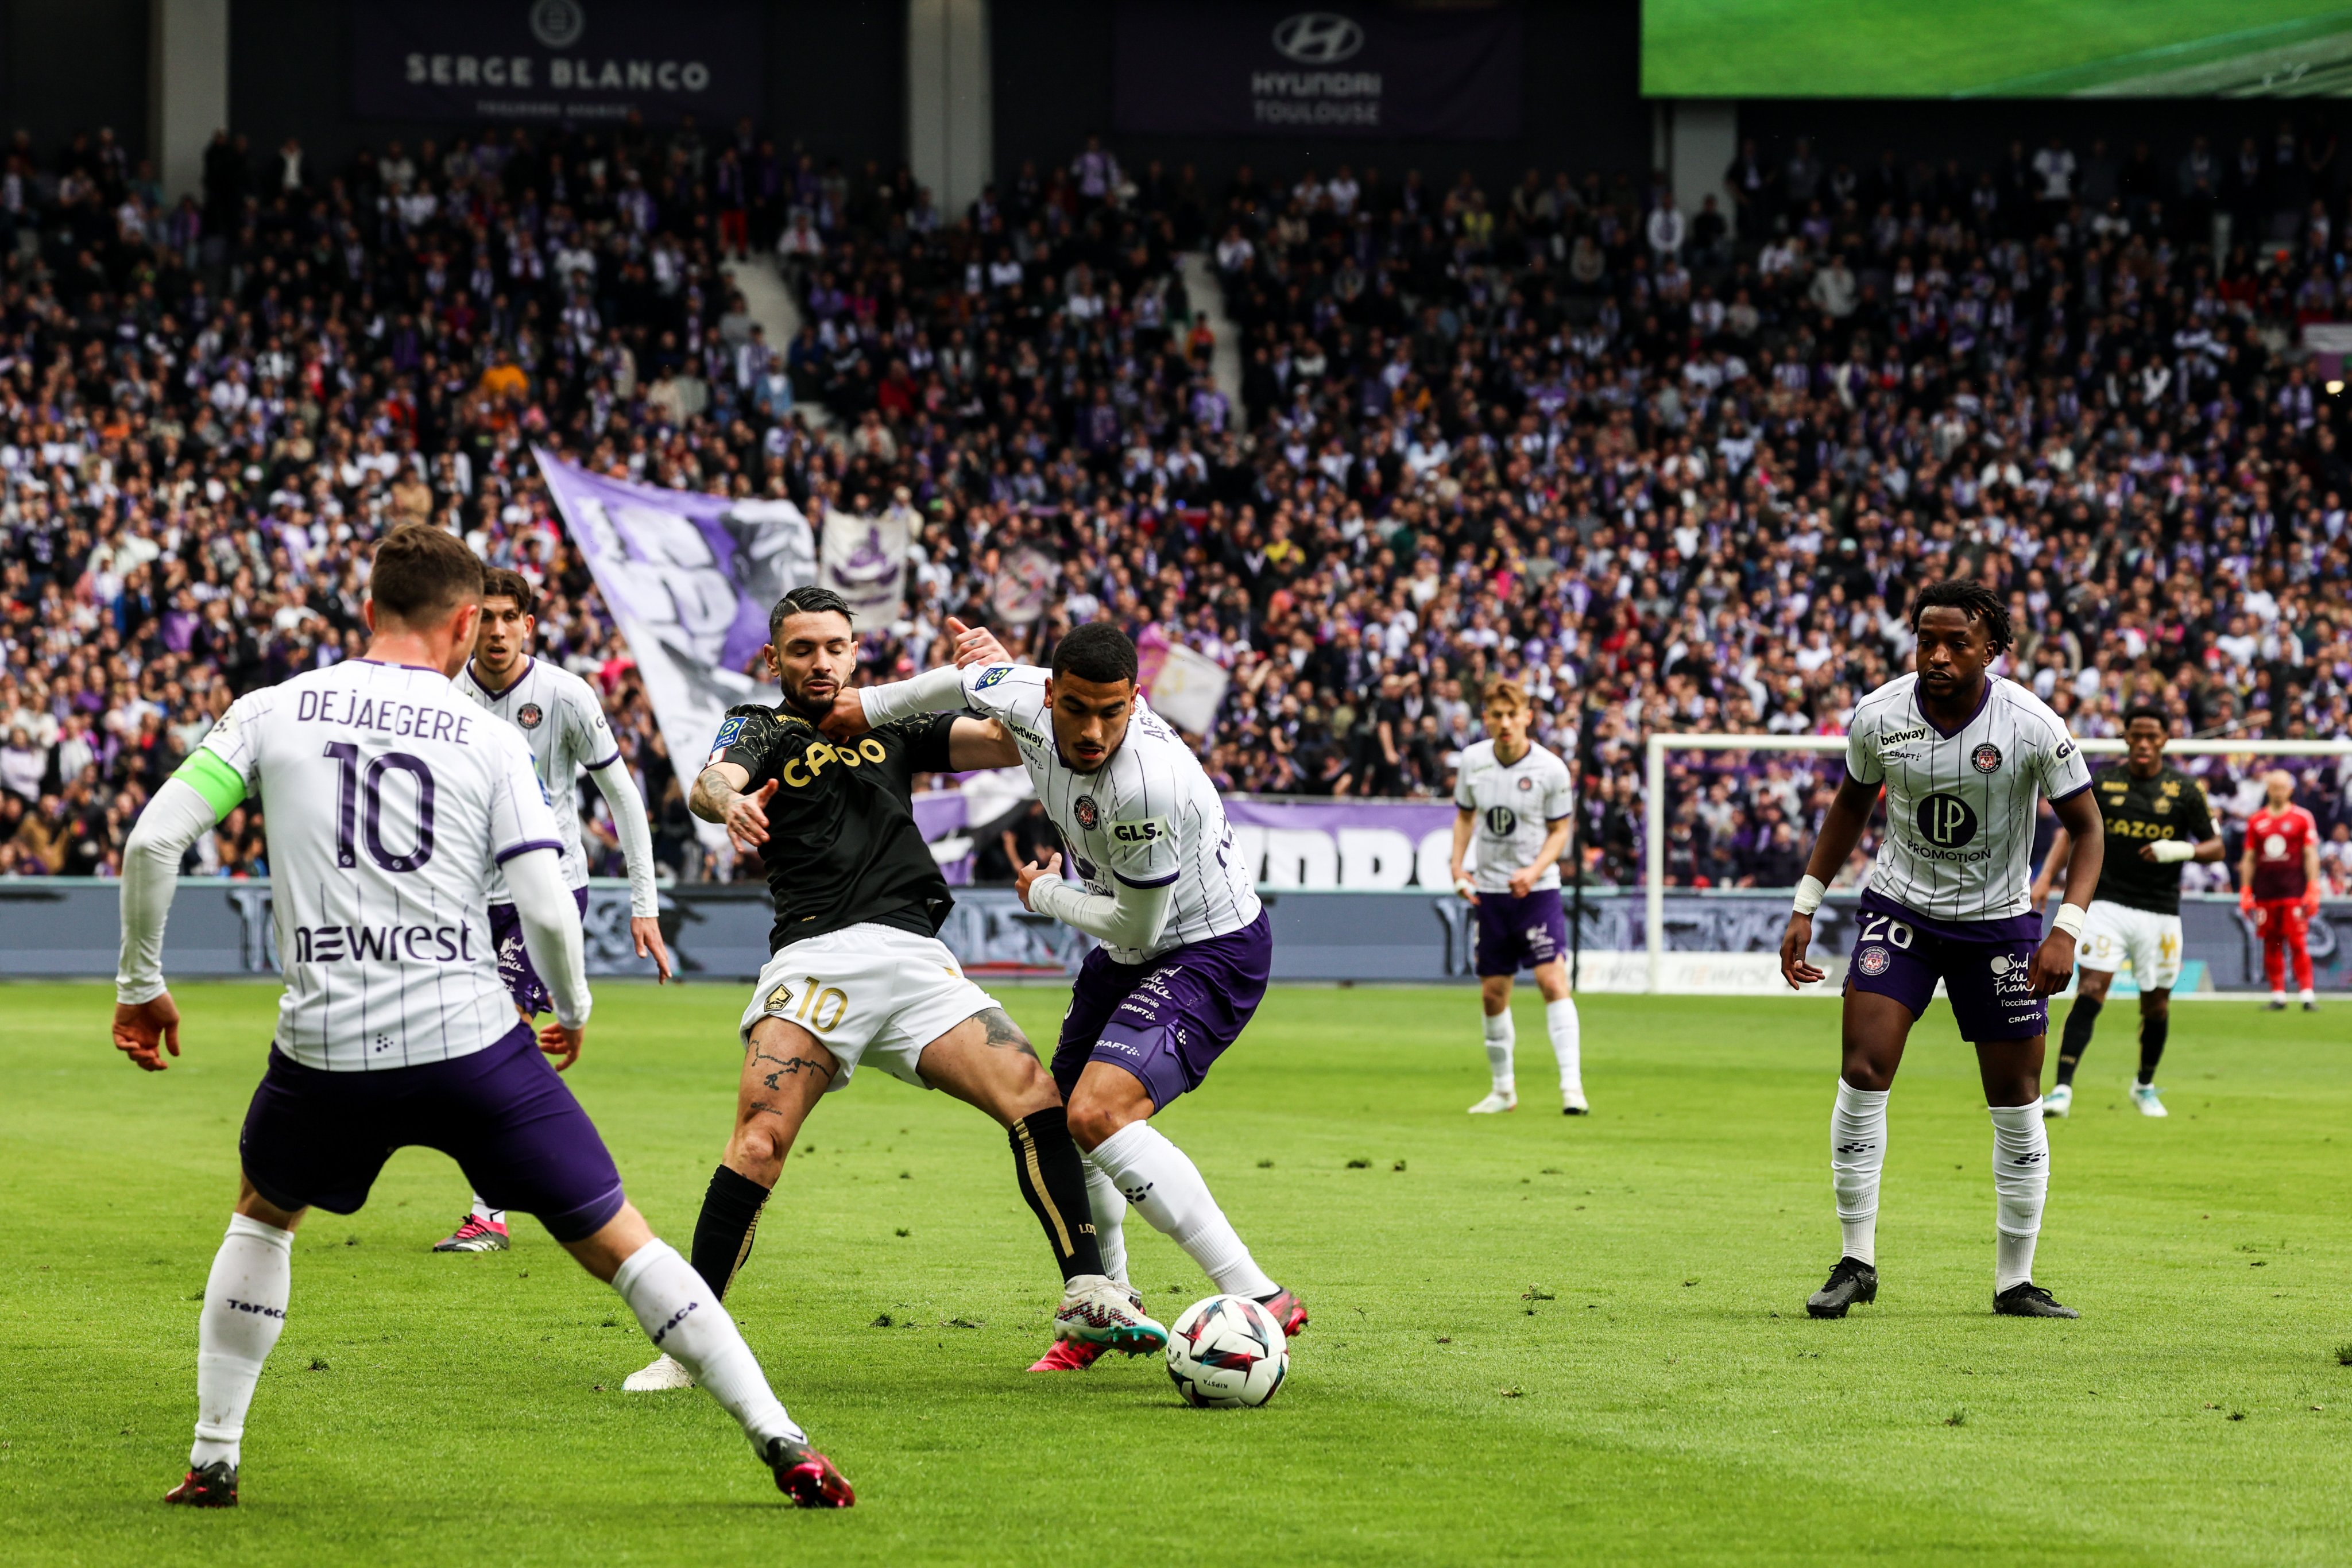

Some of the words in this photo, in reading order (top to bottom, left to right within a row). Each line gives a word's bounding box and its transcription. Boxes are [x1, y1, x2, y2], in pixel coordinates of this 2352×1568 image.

[405, 52, 534, 88] SERGE
[549, 57, 712, 93] BLANCO
[1008, 721, 1044, 748] betway
[1880, 727, 1926, 746] betway
[783, 738, 886, 787] CAOO
[1020, 746, 1038, 765] CRAFT
[1890, 751, 1916, 760] CRAFT
[323, 741, 435, 873] 10
[1493, 808, 1512, 833] LP
[1933, 797, 1965, 843] LP
[1114, 822, 1163, 842] GLS.
[1908, 839, 1991, 863] PROMOTION
[1860, 911, 1913, 949] 26
[1861, 965, 1875, 974] FOOTBALL
[2004, 952, 2029, 970] Sud
[2010, 970, 2027, 982] de
[795, 976, 848, 1034] 10
[1121, 1004, 1148, 1016] CRAFT
[2009, 1013, 2036, 1023] CRAFT
[1203, 1379, 1228, 1389] KIPSTA
